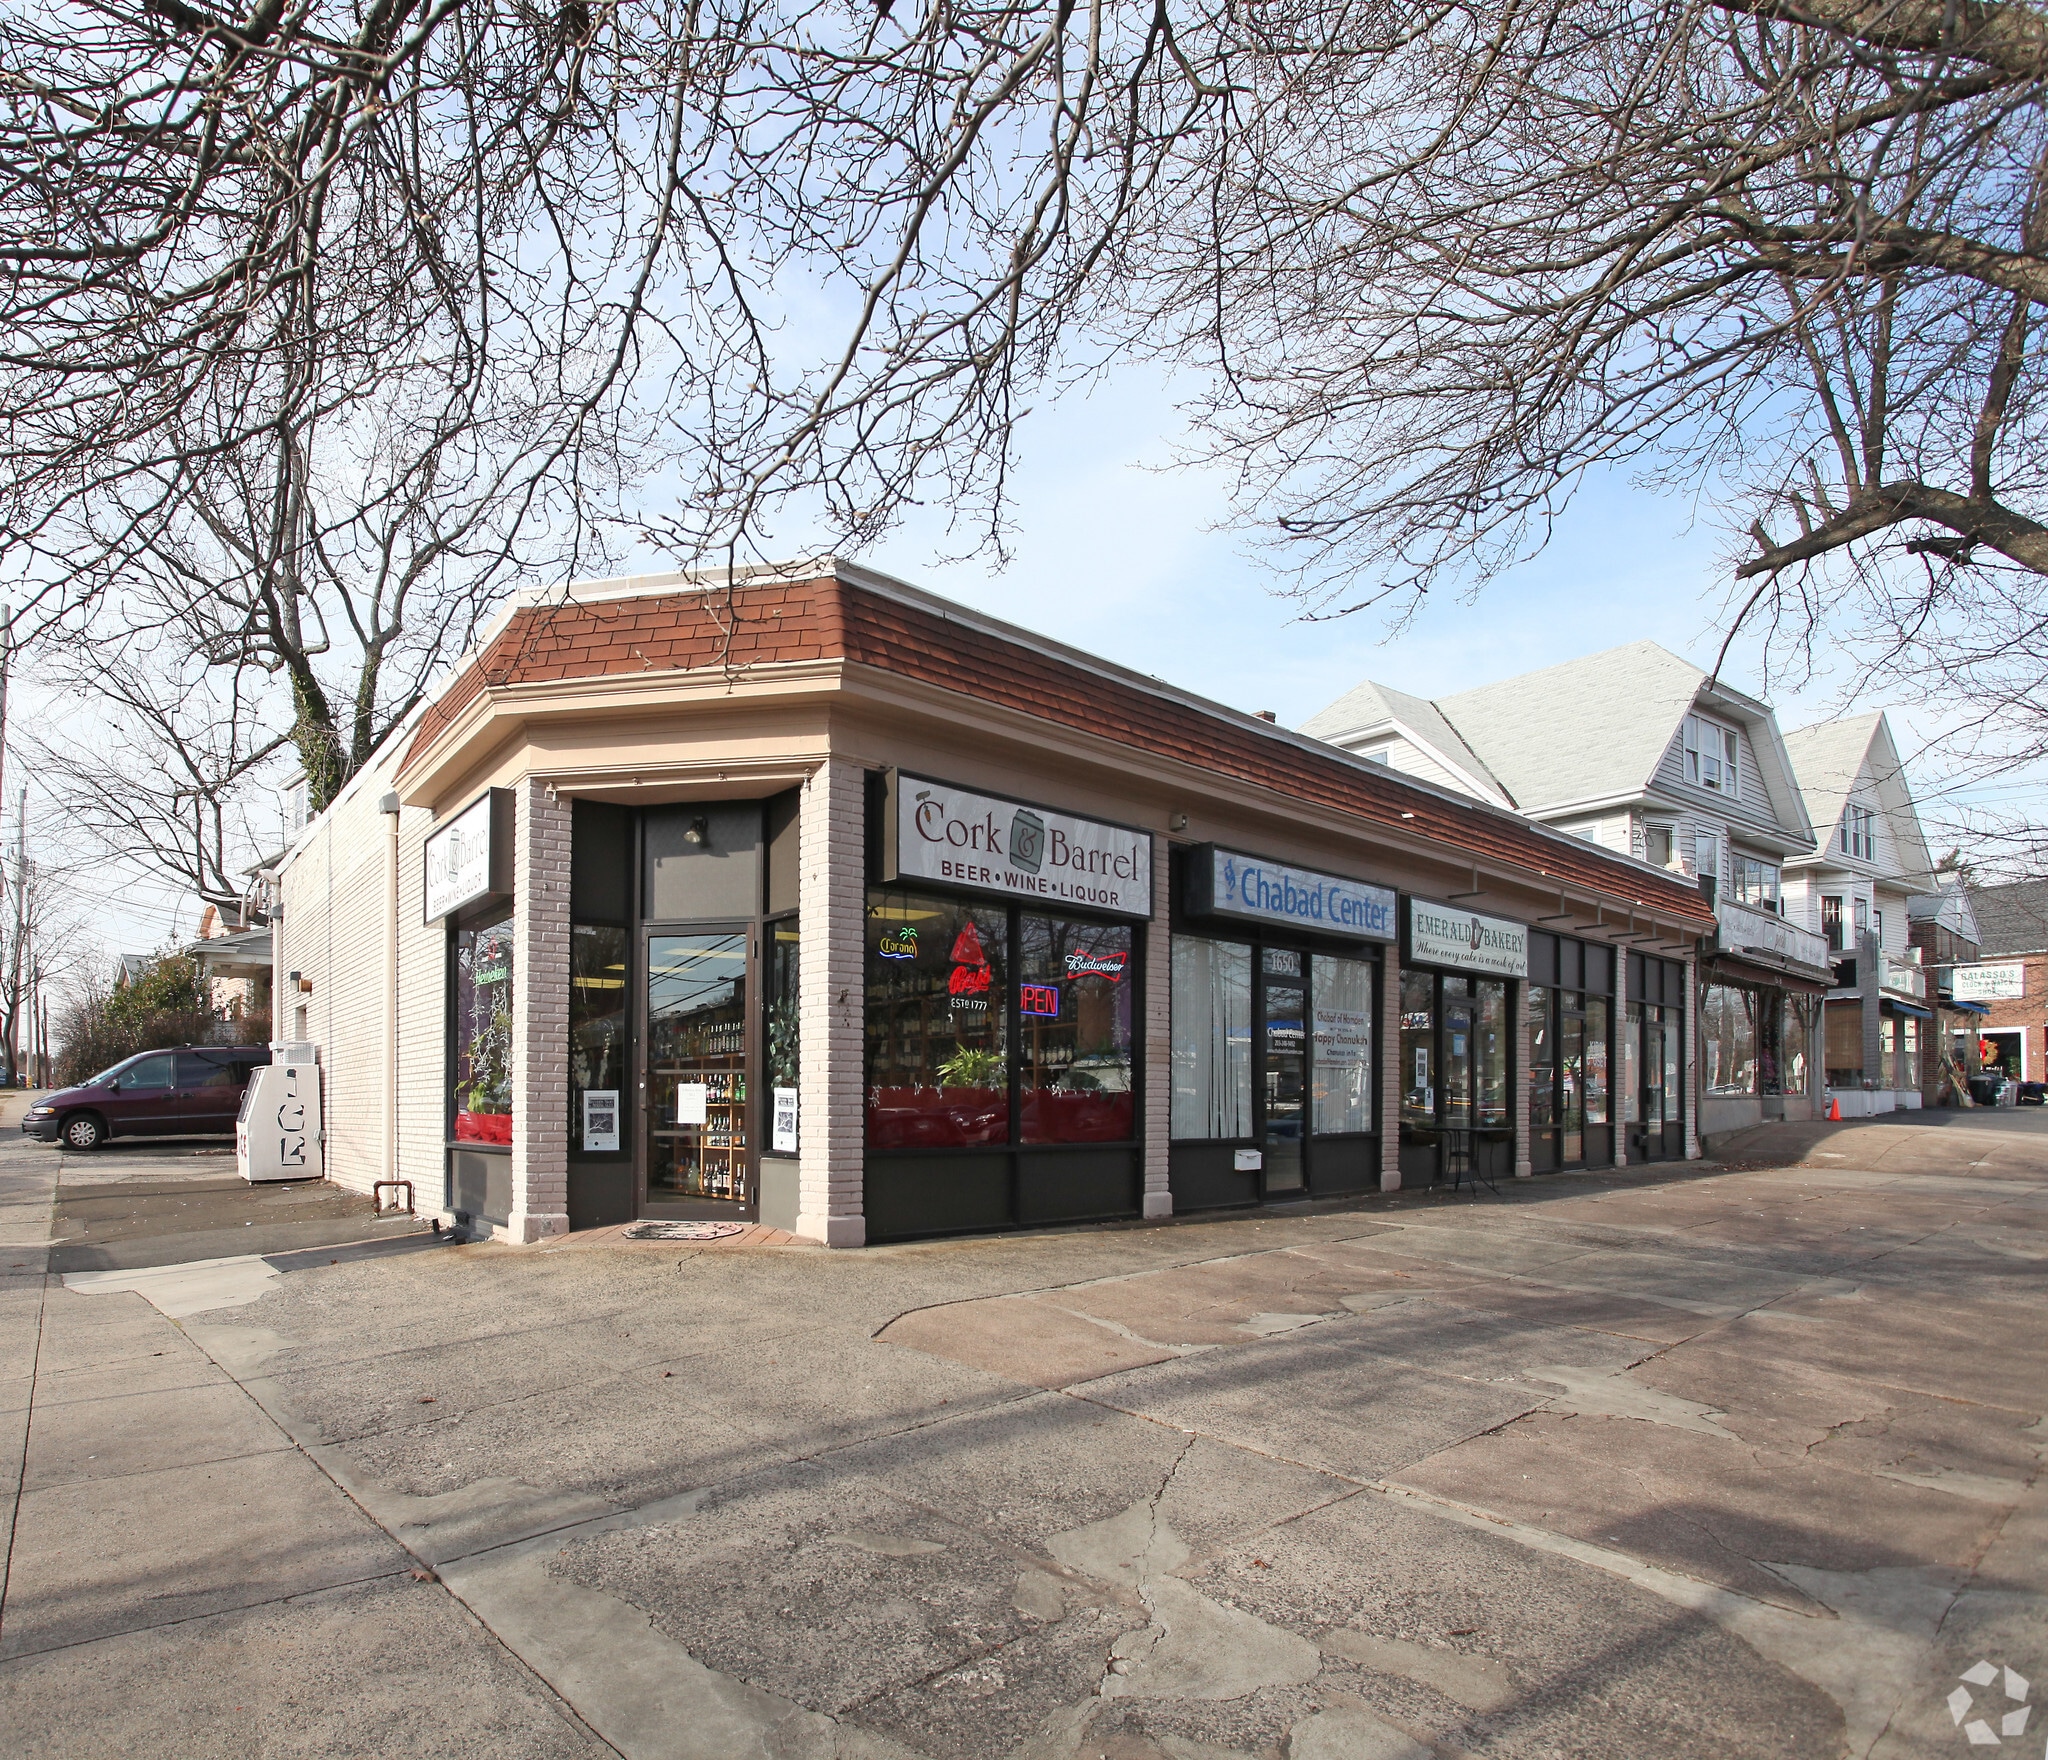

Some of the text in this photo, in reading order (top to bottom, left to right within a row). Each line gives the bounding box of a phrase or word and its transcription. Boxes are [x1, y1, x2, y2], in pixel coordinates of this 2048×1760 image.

[915, 801, 1139, 881] Cork & Barrel
[942, 860, 1119, 906] BEER WINE LIQUOR
[1241, 867, 1389, 931] Chabad Center
[1417, 913, 1524, 953] EMERALD BAKERY
[880, 937, 915, 954] Corona
[1416, 940, 1439, 956] Where
[1440, 950, 1460, 964] every
[1461, 951, 1476, 961] cake
[476, 966, 507, 984] Heineken
[1065, 954, 1124, 972] Budweiser
[971, 1000, 988, 1011] 1777
